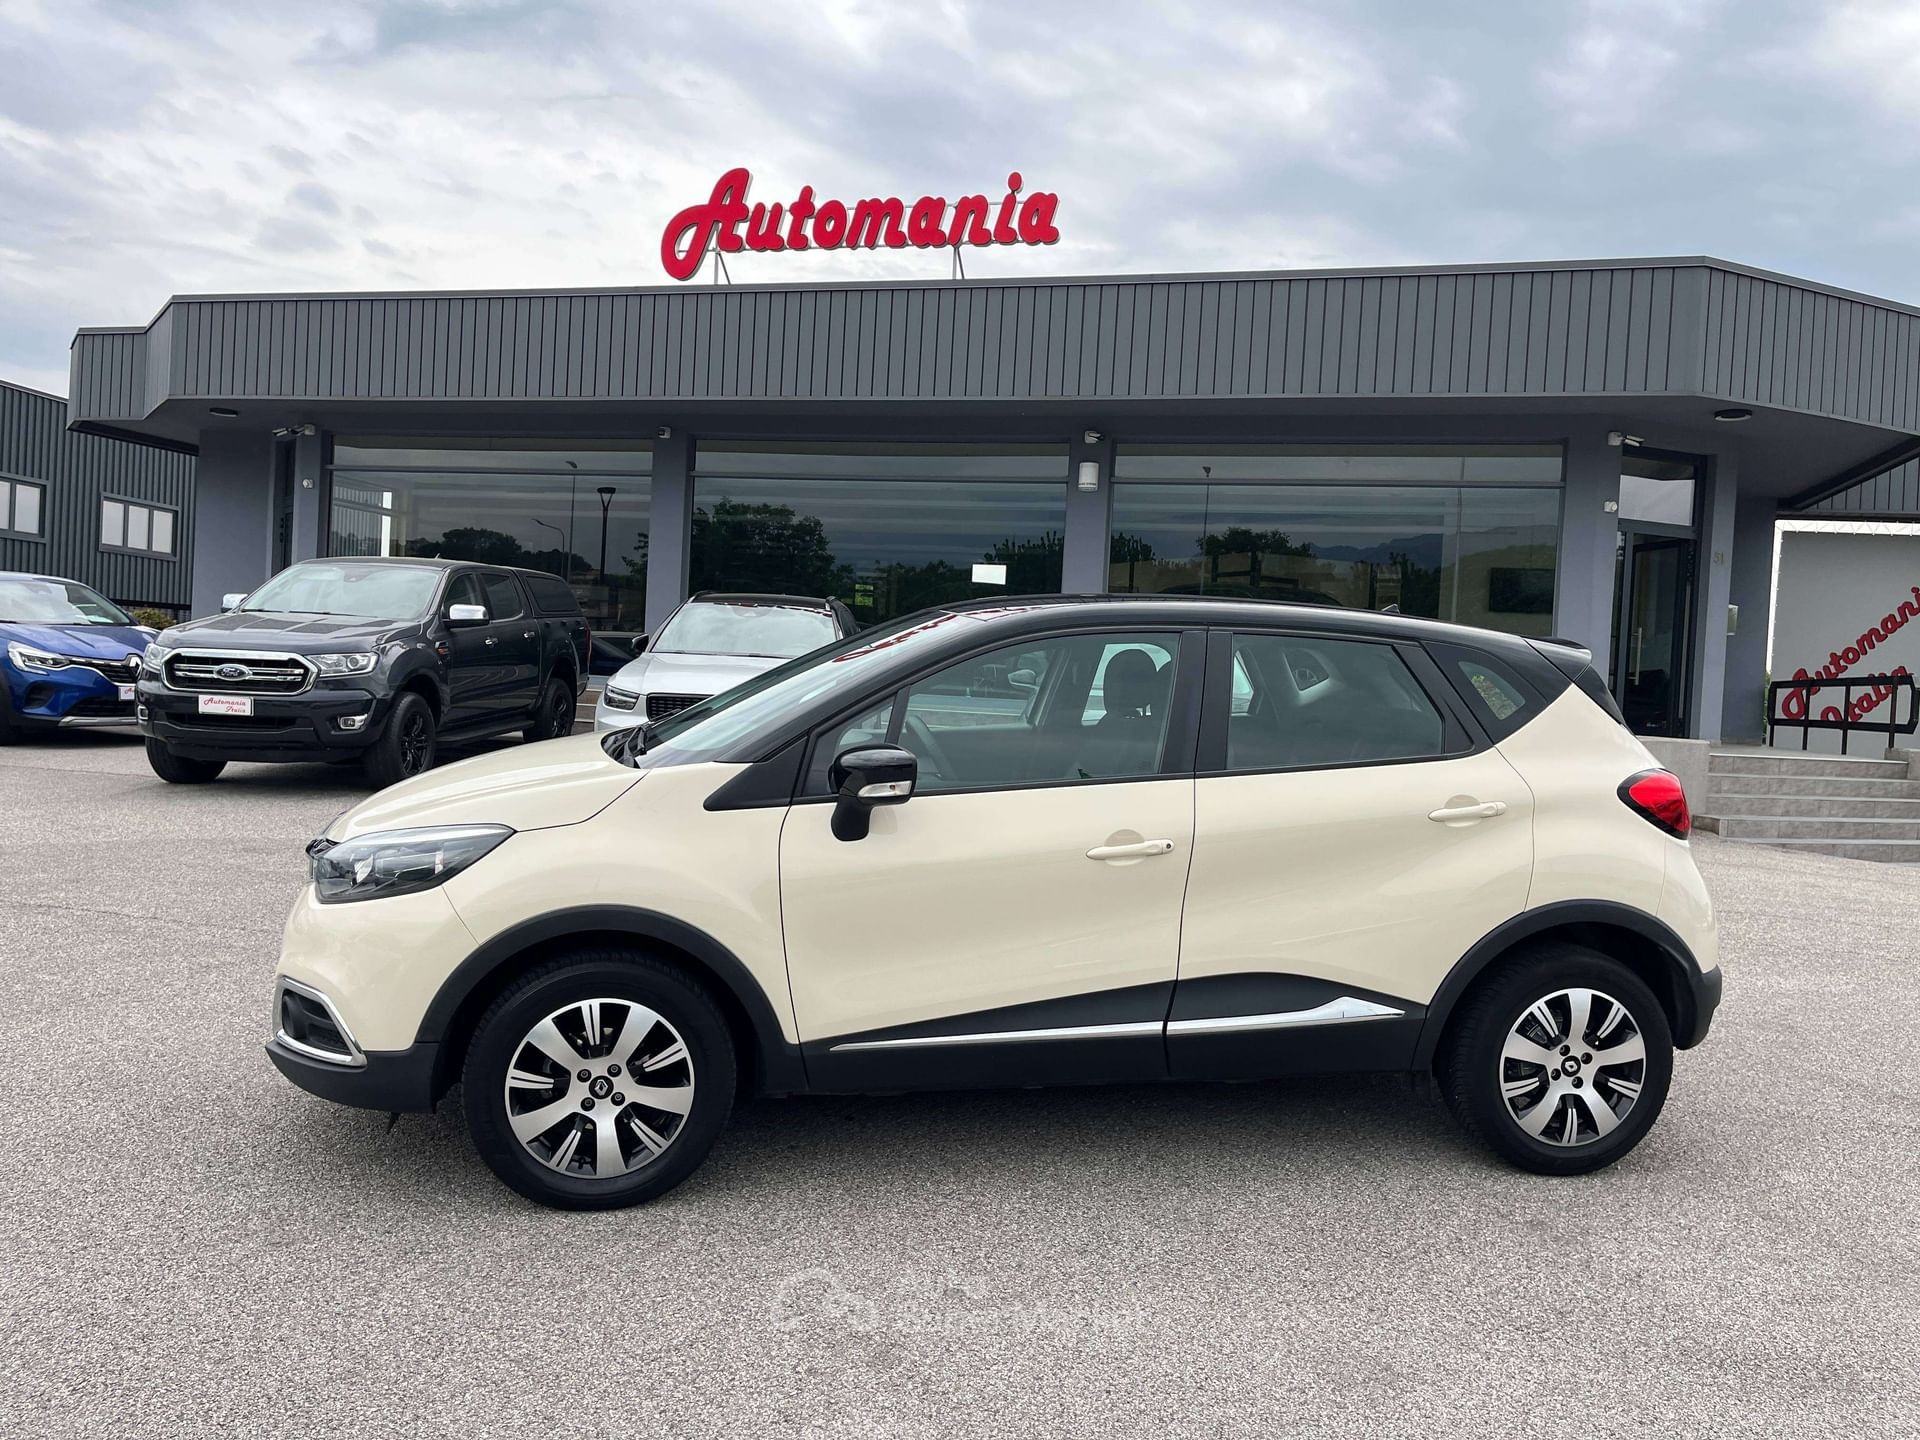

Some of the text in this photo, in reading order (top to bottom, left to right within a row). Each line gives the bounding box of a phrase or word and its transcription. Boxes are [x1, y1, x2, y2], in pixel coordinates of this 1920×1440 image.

[661, 168, 1061, 281] Automania
[220, 667, 240, 677] Ford
[204, 697, 246, 706] Automania
